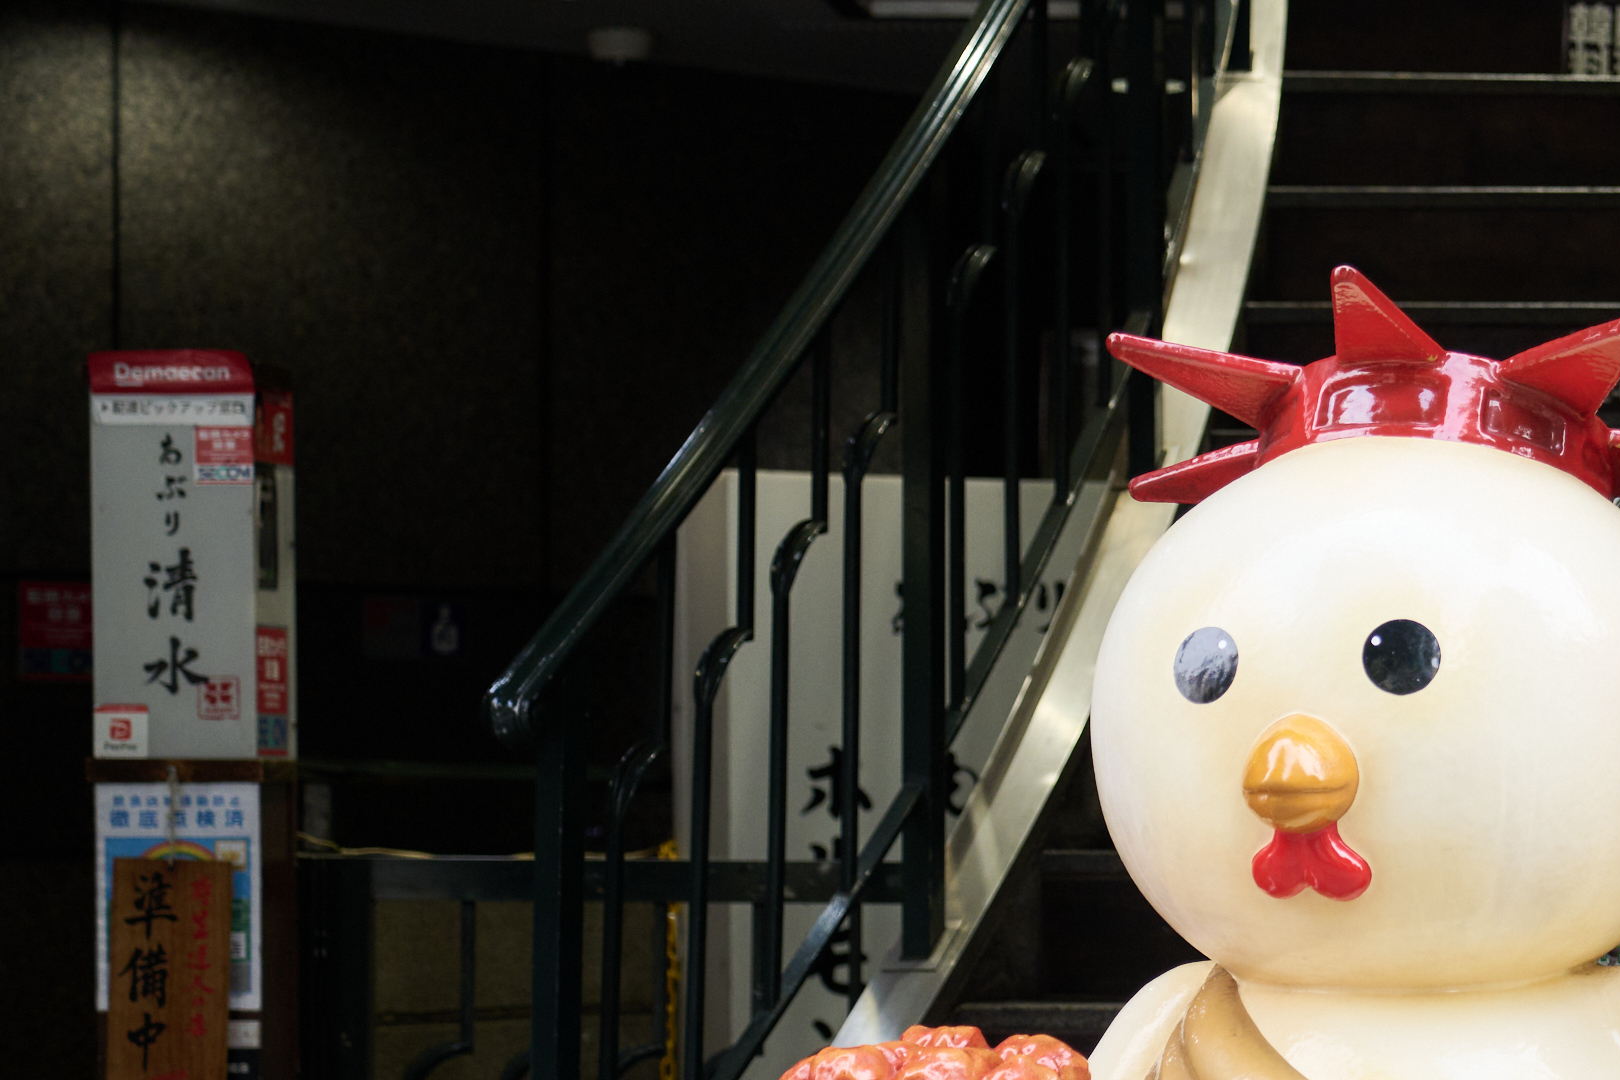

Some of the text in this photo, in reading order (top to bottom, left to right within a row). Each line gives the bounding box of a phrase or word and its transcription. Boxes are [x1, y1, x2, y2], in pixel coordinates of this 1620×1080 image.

[113, 361, 231, 382] Demaecan
[119, 871, 178, 1071] 準備中
